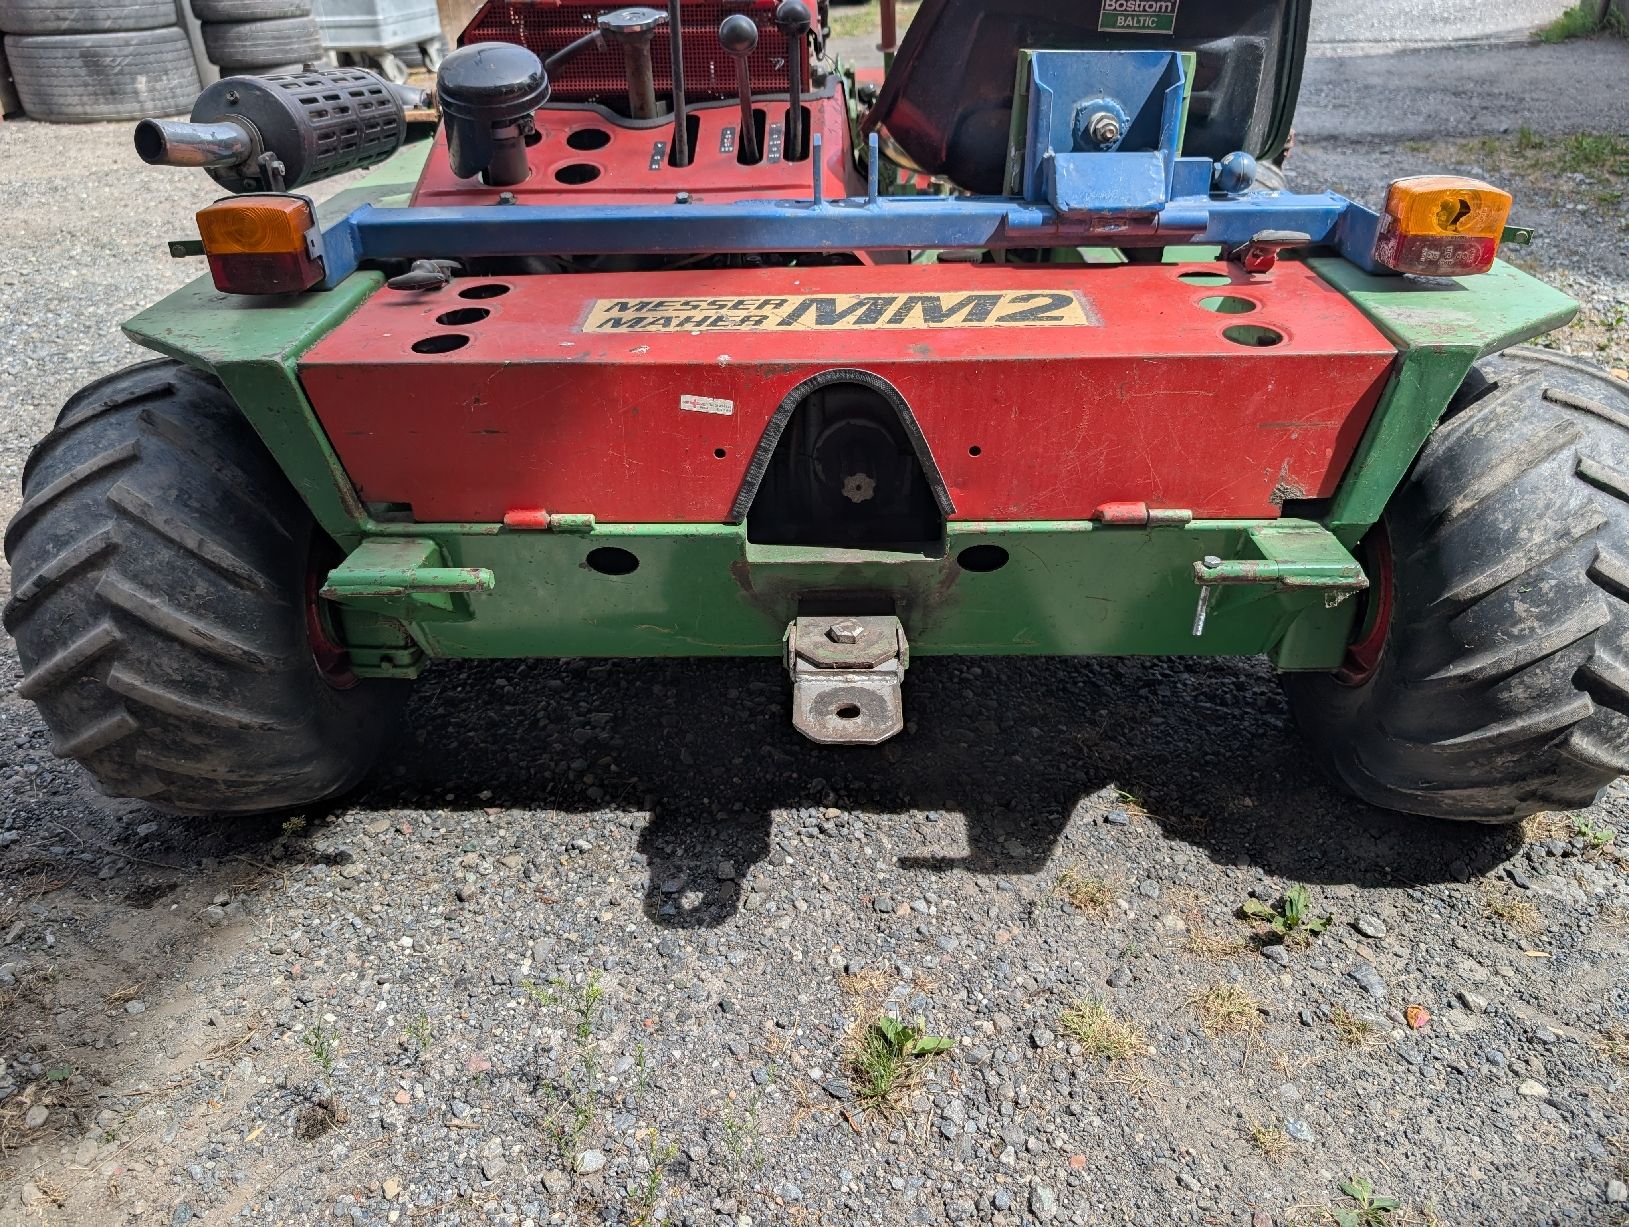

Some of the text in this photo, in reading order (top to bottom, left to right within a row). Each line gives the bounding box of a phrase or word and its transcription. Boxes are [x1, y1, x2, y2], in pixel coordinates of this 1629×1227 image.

[1104, 0, 1172, 12] Bostrom
[1116, 16, 1158, 27] BALTIC
[603, 298, 789, 313] MESSER
[775, 292, 1074, 327] MM2
